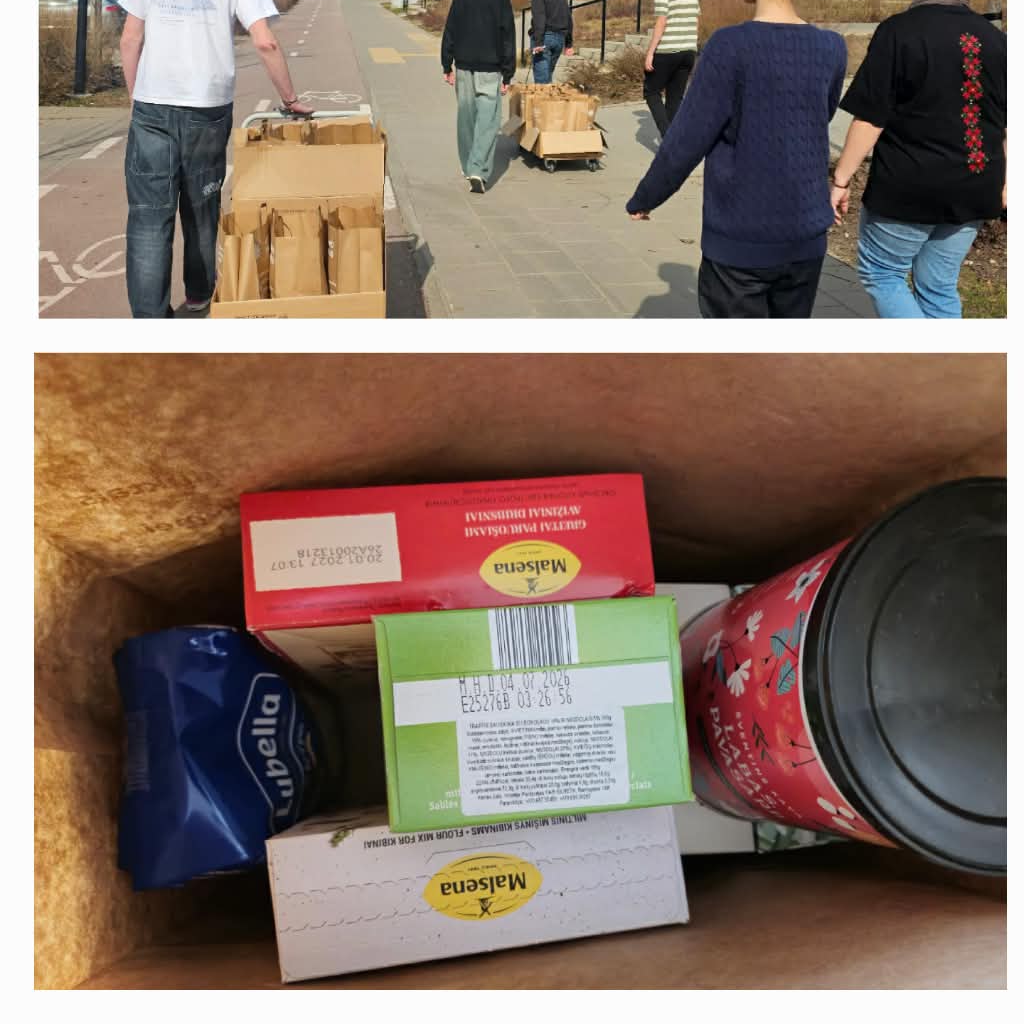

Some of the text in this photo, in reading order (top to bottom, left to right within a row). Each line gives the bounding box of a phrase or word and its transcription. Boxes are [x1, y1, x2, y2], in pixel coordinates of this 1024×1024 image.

[464, 505, 582, 524] AVIŽINIAI DRIBSNIAI
[464, 519, 588, 539] GREITAI PARUOŠIAMI
[493, 557, 567, 576] Malsena
[252, 694, 294, 817] Lubella
[363, 813, 588, 850] MILTINIS MIŠINYS KIBINAMS FLOUR MIX FOR KIBINAI
[440, 871, 528, 897] Malsena
